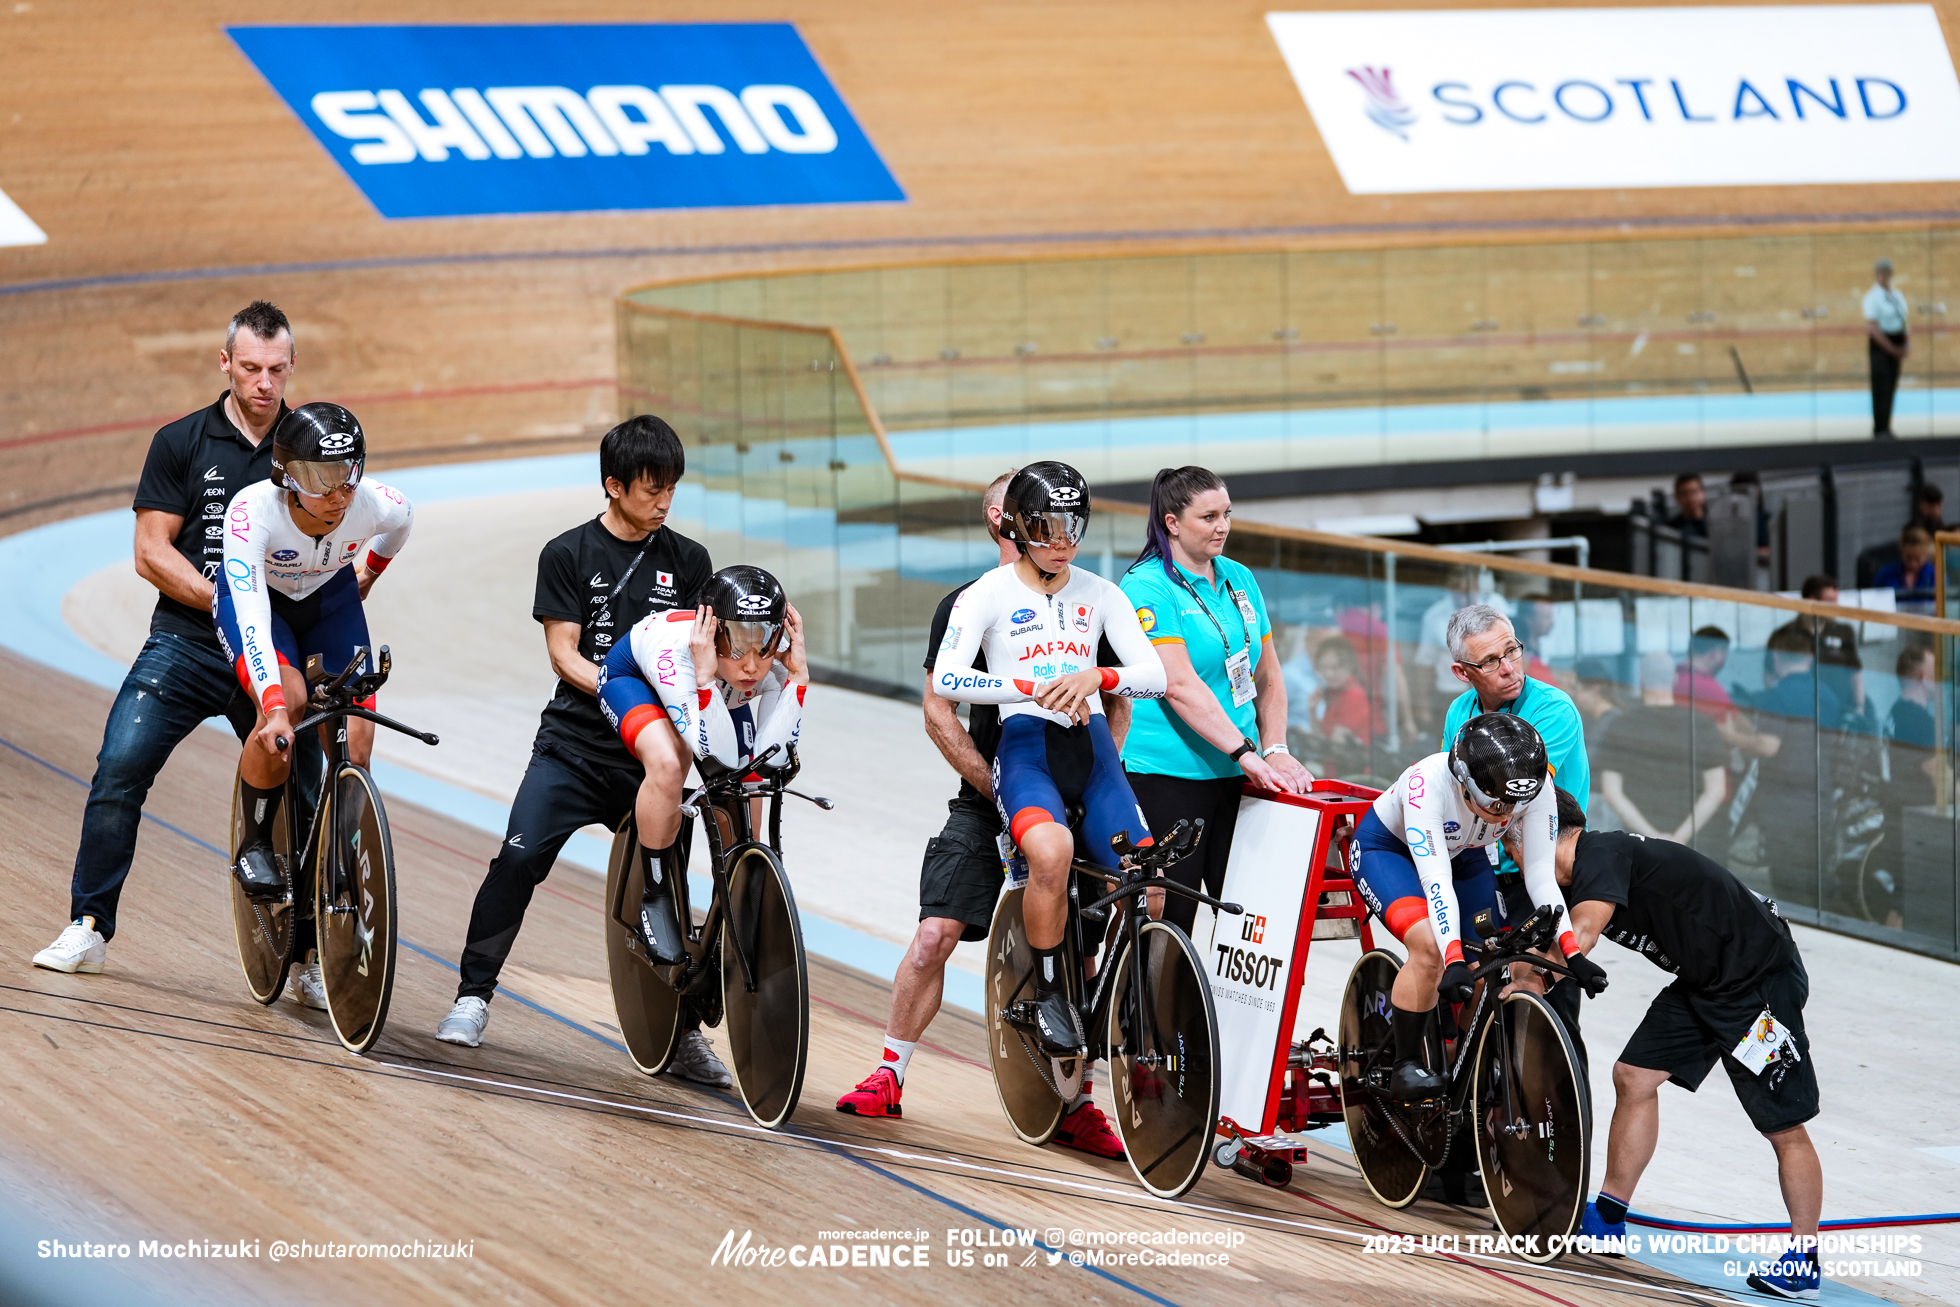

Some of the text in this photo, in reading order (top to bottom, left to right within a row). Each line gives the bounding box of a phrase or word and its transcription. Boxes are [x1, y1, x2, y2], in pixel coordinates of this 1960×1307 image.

[1432, 76, 1908, 126] SCOTLAND
[311, 85, 838, 165] SHIMANO
[321, 447, 355, 456] Kabuto
[265, 559, 302, 568] SUBARU
[216, 626, 235, 662] SPEED
[951, 626, 963, 651] KEIRIN
[1010, 624, 1044, 637] SUBARU
[245, 625, 268, 682] Cyclers
[1018, 641, 1091, 661] JAPAN
[941, 673, 1003, 690] Cyclers
[1118, 686, 1165, 699] Cyclers
[600, 697, 619, 727] SPEED
[1505, 789, 1536, 797] Kabuto
[1425, 829, 1437, 857] KEIRIN
[239, 856, 257, 880] Q36.5
[1357, 877, 1383, 913] SPEED
[1430, 882, 1450, 935] Cyclers
[640, 910, 658, 946] Q36.5
[1216, 943, 1283, 991] TISSOT
[1224, 990, 1248, 1005] WATCHES
[1248, 995, 1264, 1009] SINCE
[1037, 1008, 1053, 1037] Q36.5
[1177, 1031, 1186, 1072] JAPAN
[1545, 1097, 1555, 1137] JAPAN
